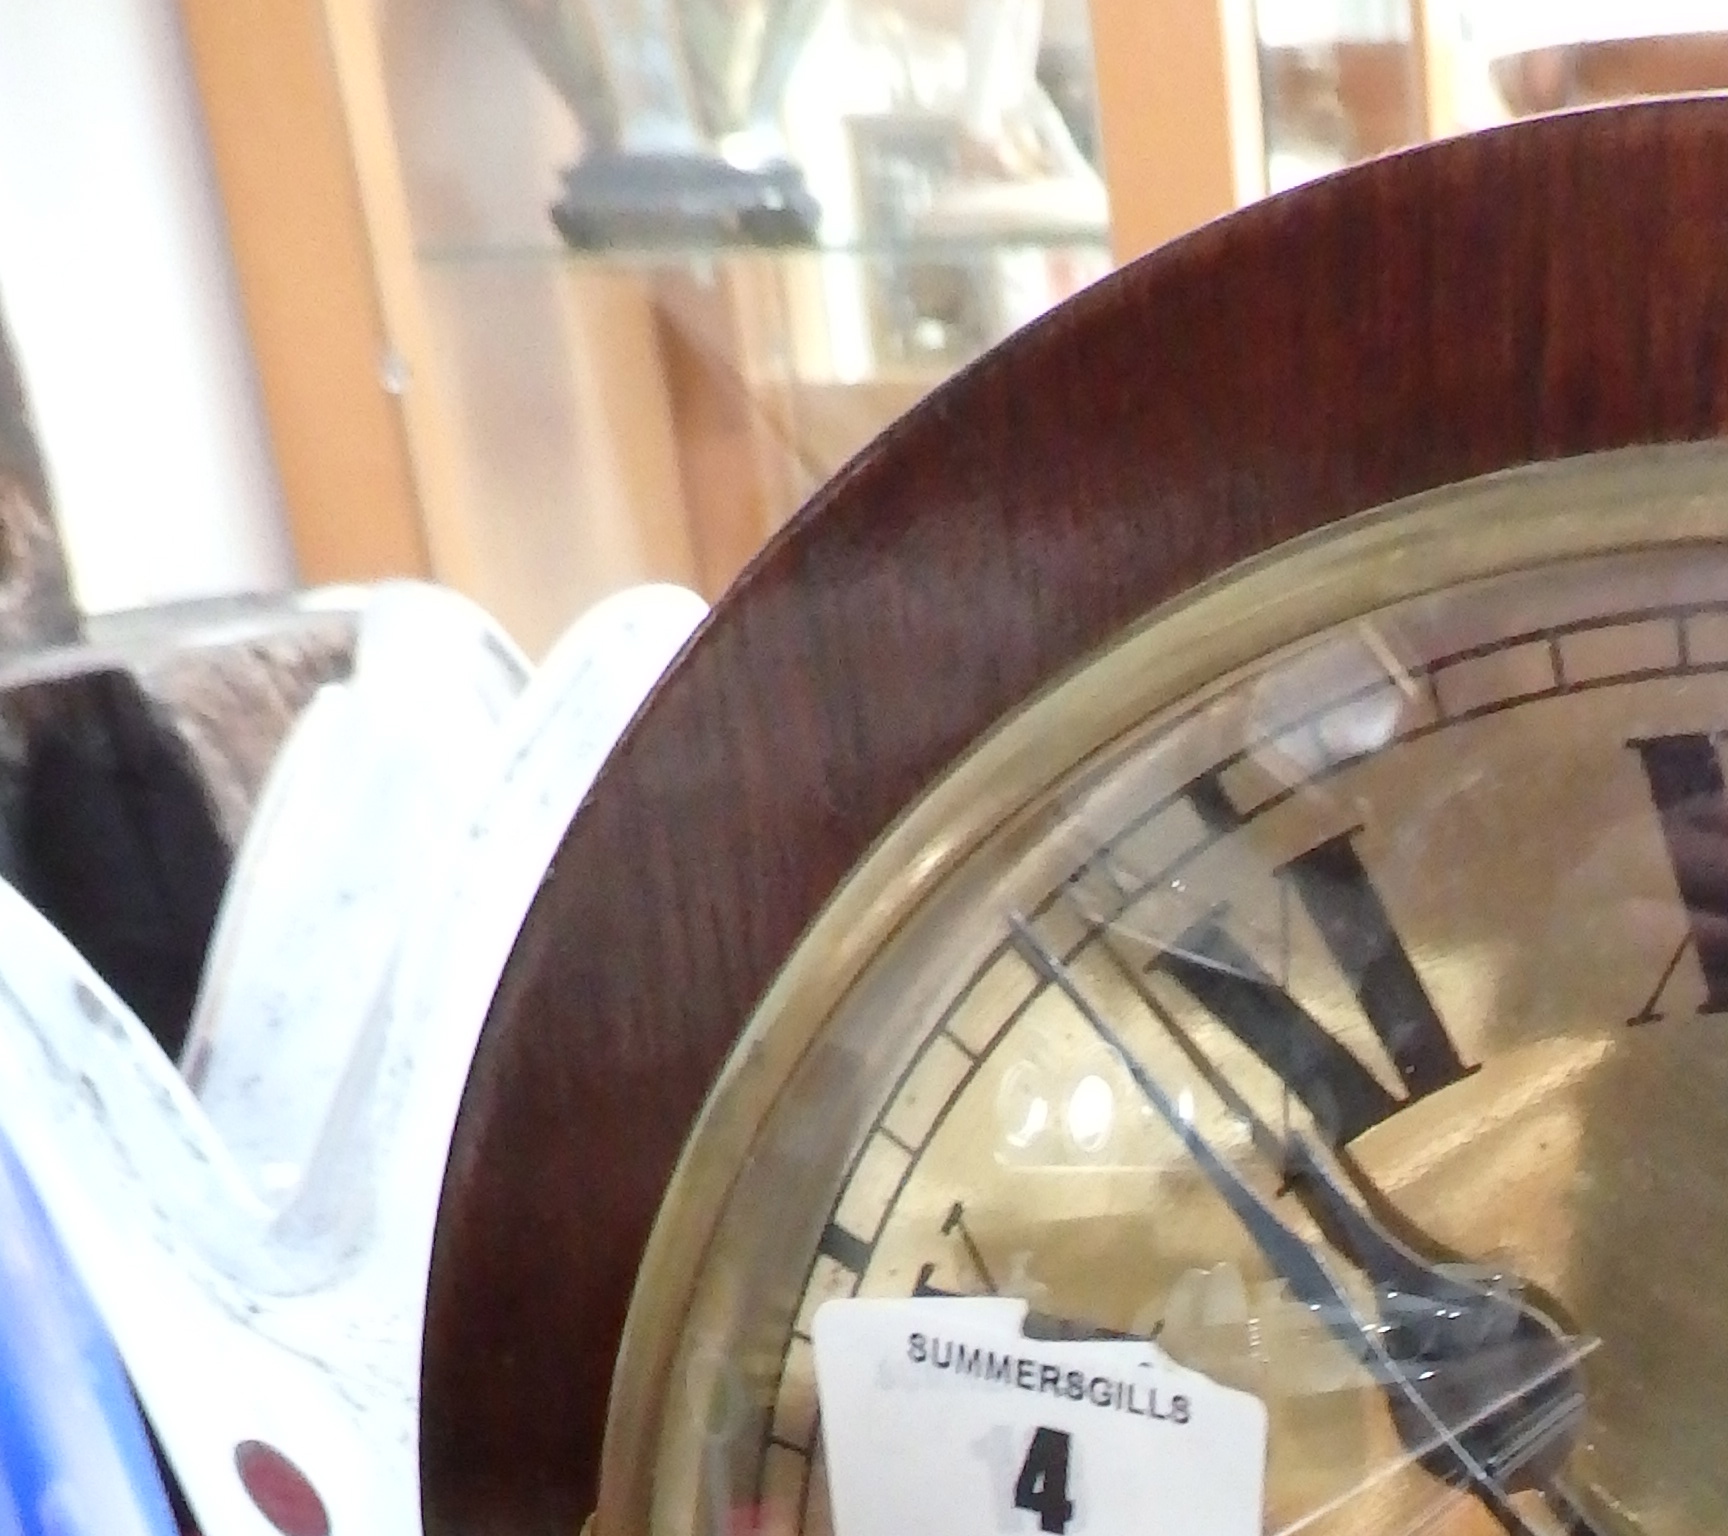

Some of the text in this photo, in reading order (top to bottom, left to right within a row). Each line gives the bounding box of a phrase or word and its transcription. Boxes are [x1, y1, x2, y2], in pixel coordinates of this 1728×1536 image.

[1145, 823, 1483, 1194] XI
[906, 1330, 1193, 1425] SUMMERSGILLS
[1015, 1426, 1074, 1536] 4
